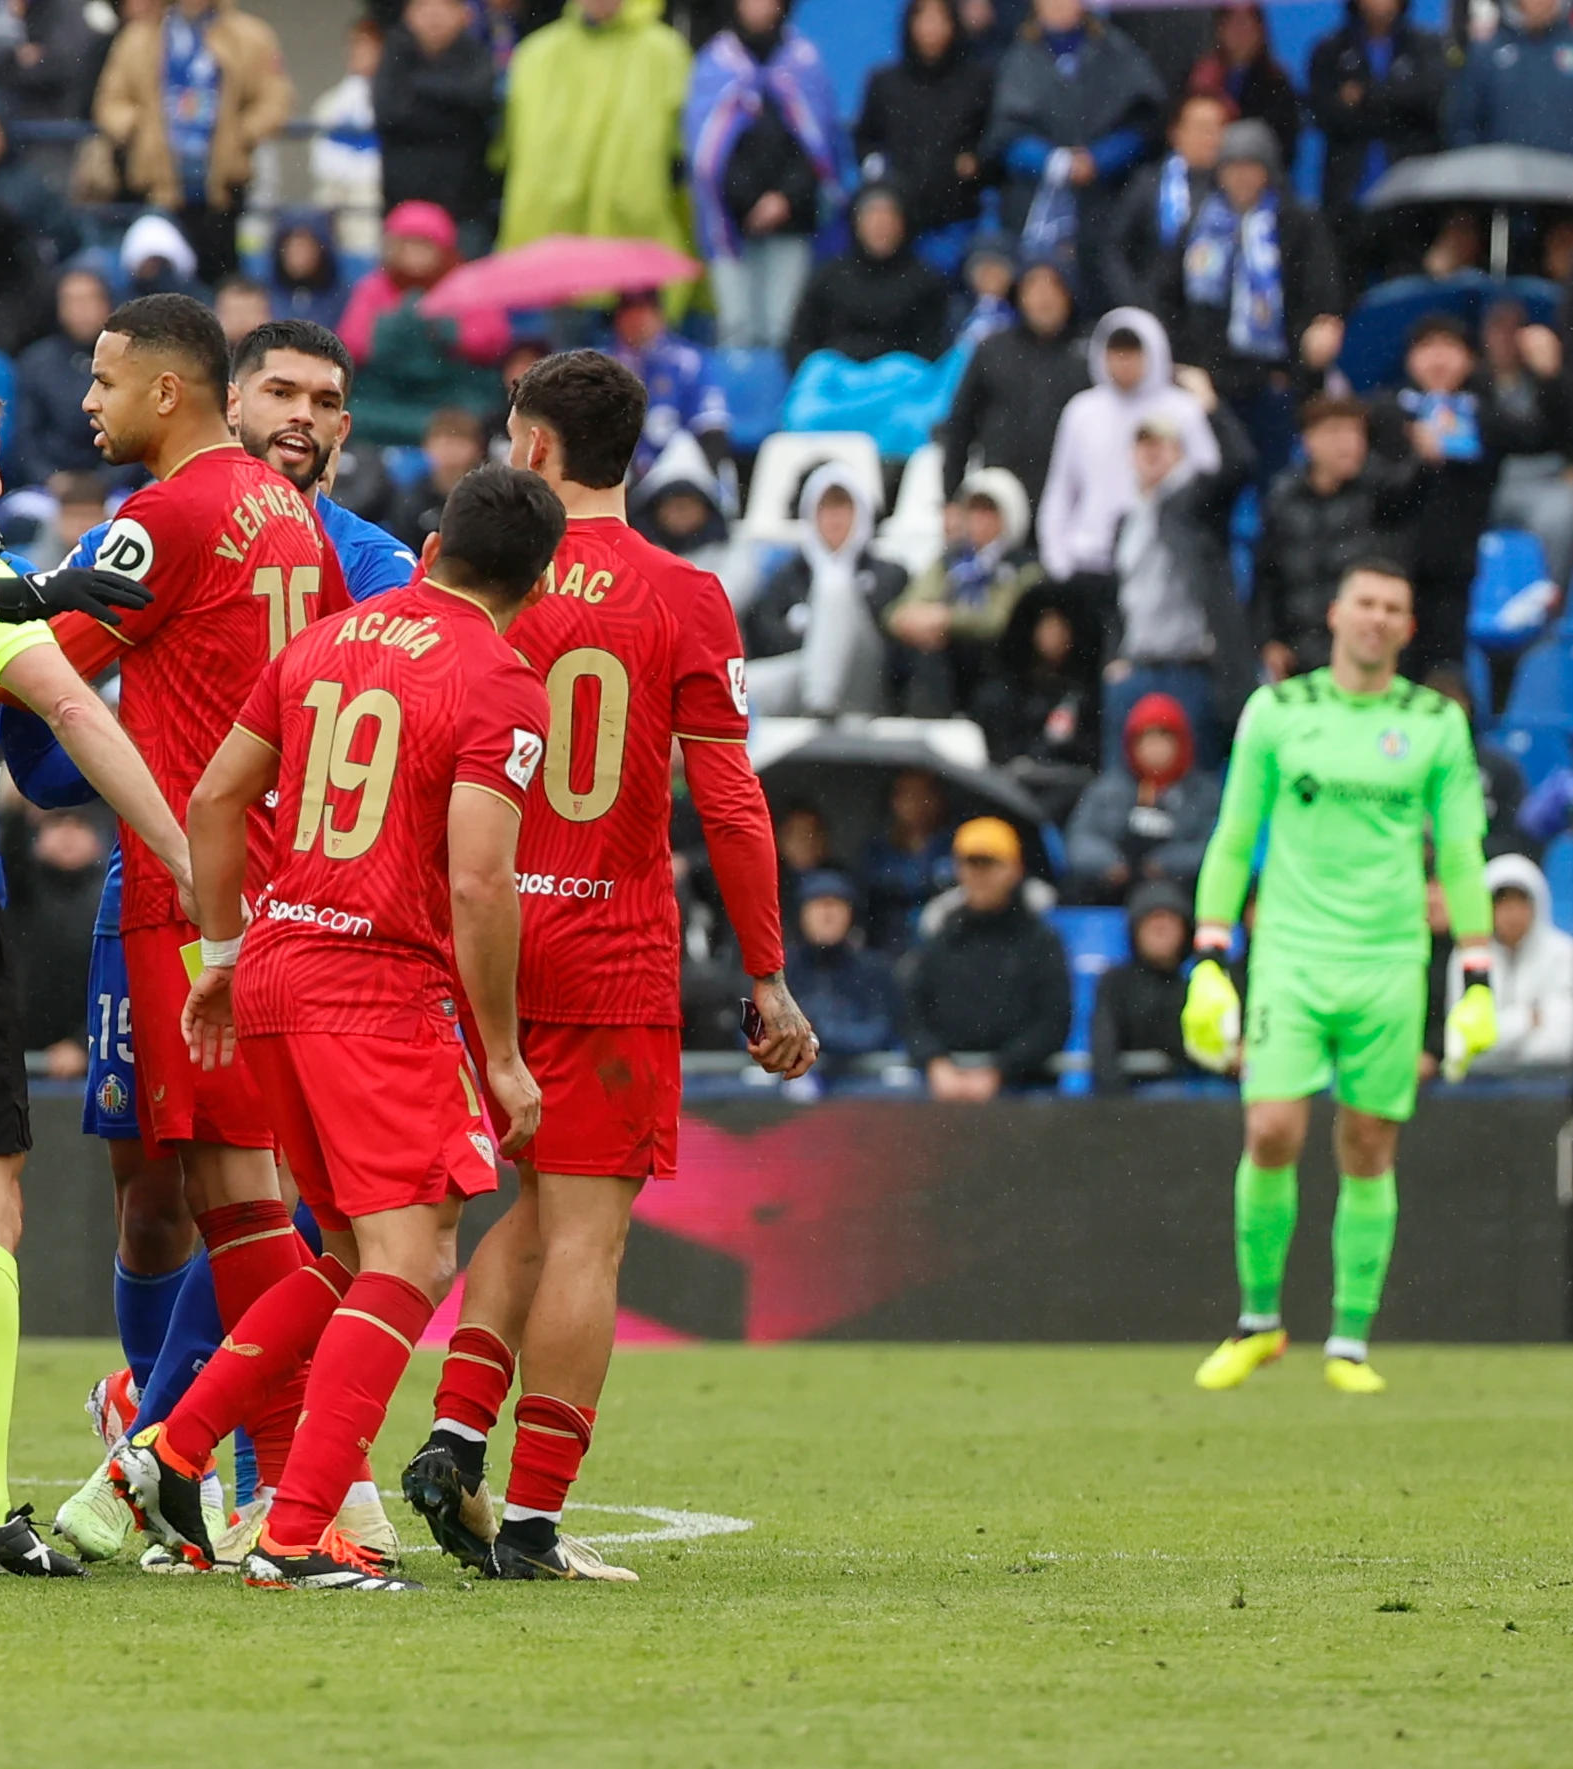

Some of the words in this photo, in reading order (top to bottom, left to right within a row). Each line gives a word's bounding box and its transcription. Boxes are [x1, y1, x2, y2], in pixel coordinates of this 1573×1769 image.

[99, 534, 145, 572] JD
[335, 611, 441, 660] ACUÑA
[293, 679, 402, 860] 19
